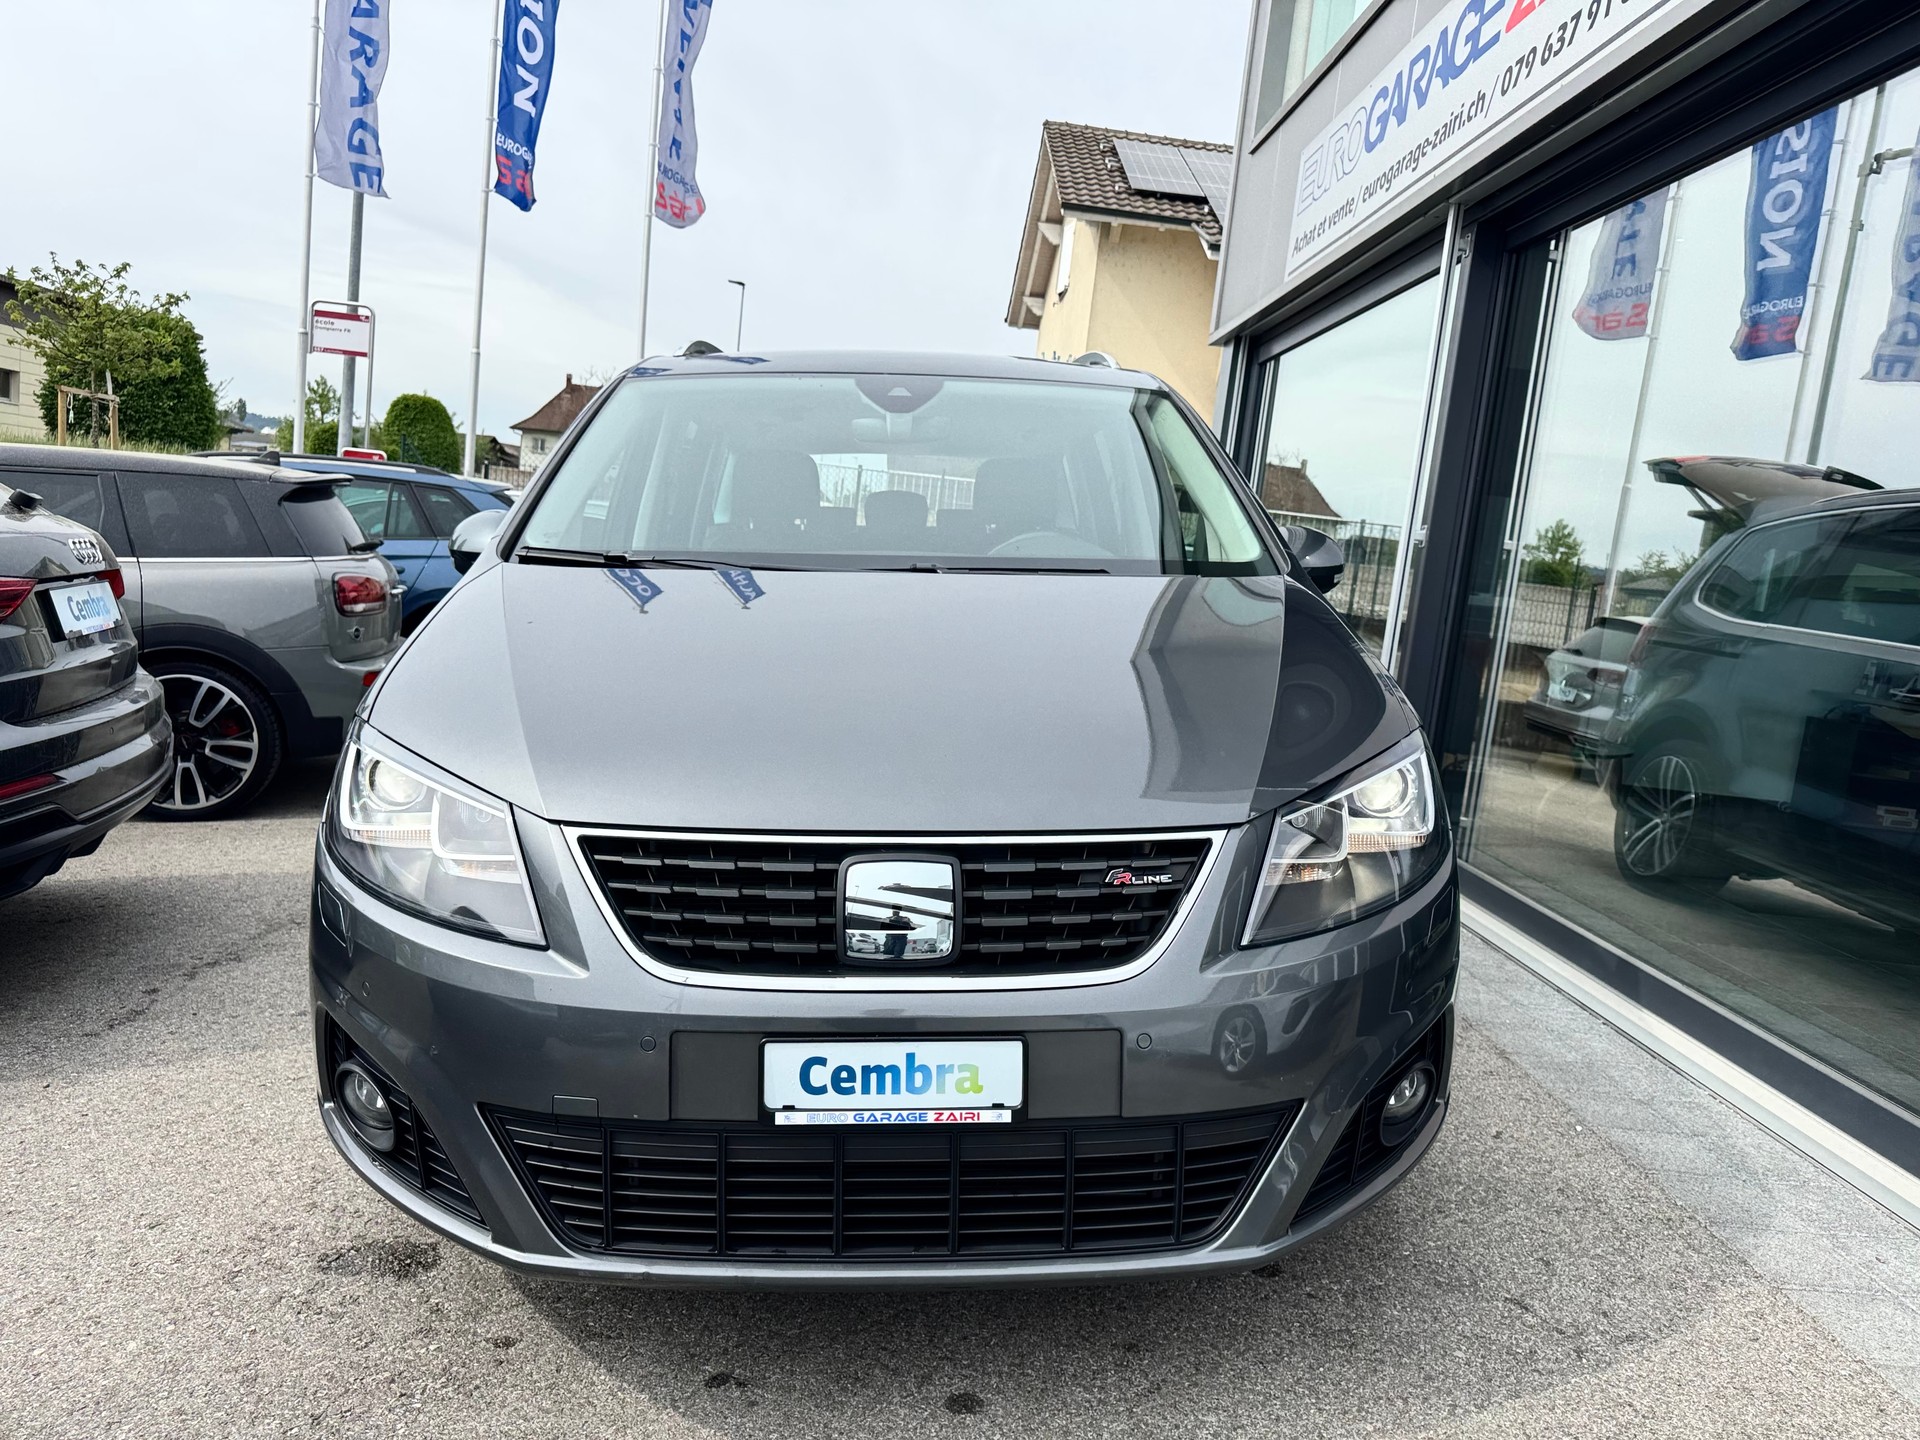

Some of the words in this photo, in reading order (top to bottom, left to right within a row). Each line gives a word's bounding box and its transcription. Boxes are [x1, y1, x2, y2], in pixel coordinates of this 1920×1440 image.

[1292, 222, 1318, 257] Achat
[1317, 217, 1326, 238] et
[1328, 197, 1355, 231] vente
[1362, 89, 1486, 203] eurogarage-zairi.ch
[1501, 46, 1538, 97] 079
[1540, 8, 1583, 67] 637
[66, 590, 111, 622] Cembra
[799, 1052, 983, 1096] Cembra
[806, 1113, 849, 1123] EURO
[853, 1112, 929, 1122] GARAGE
[933, 1111, 981, 1122] ZAIRI
